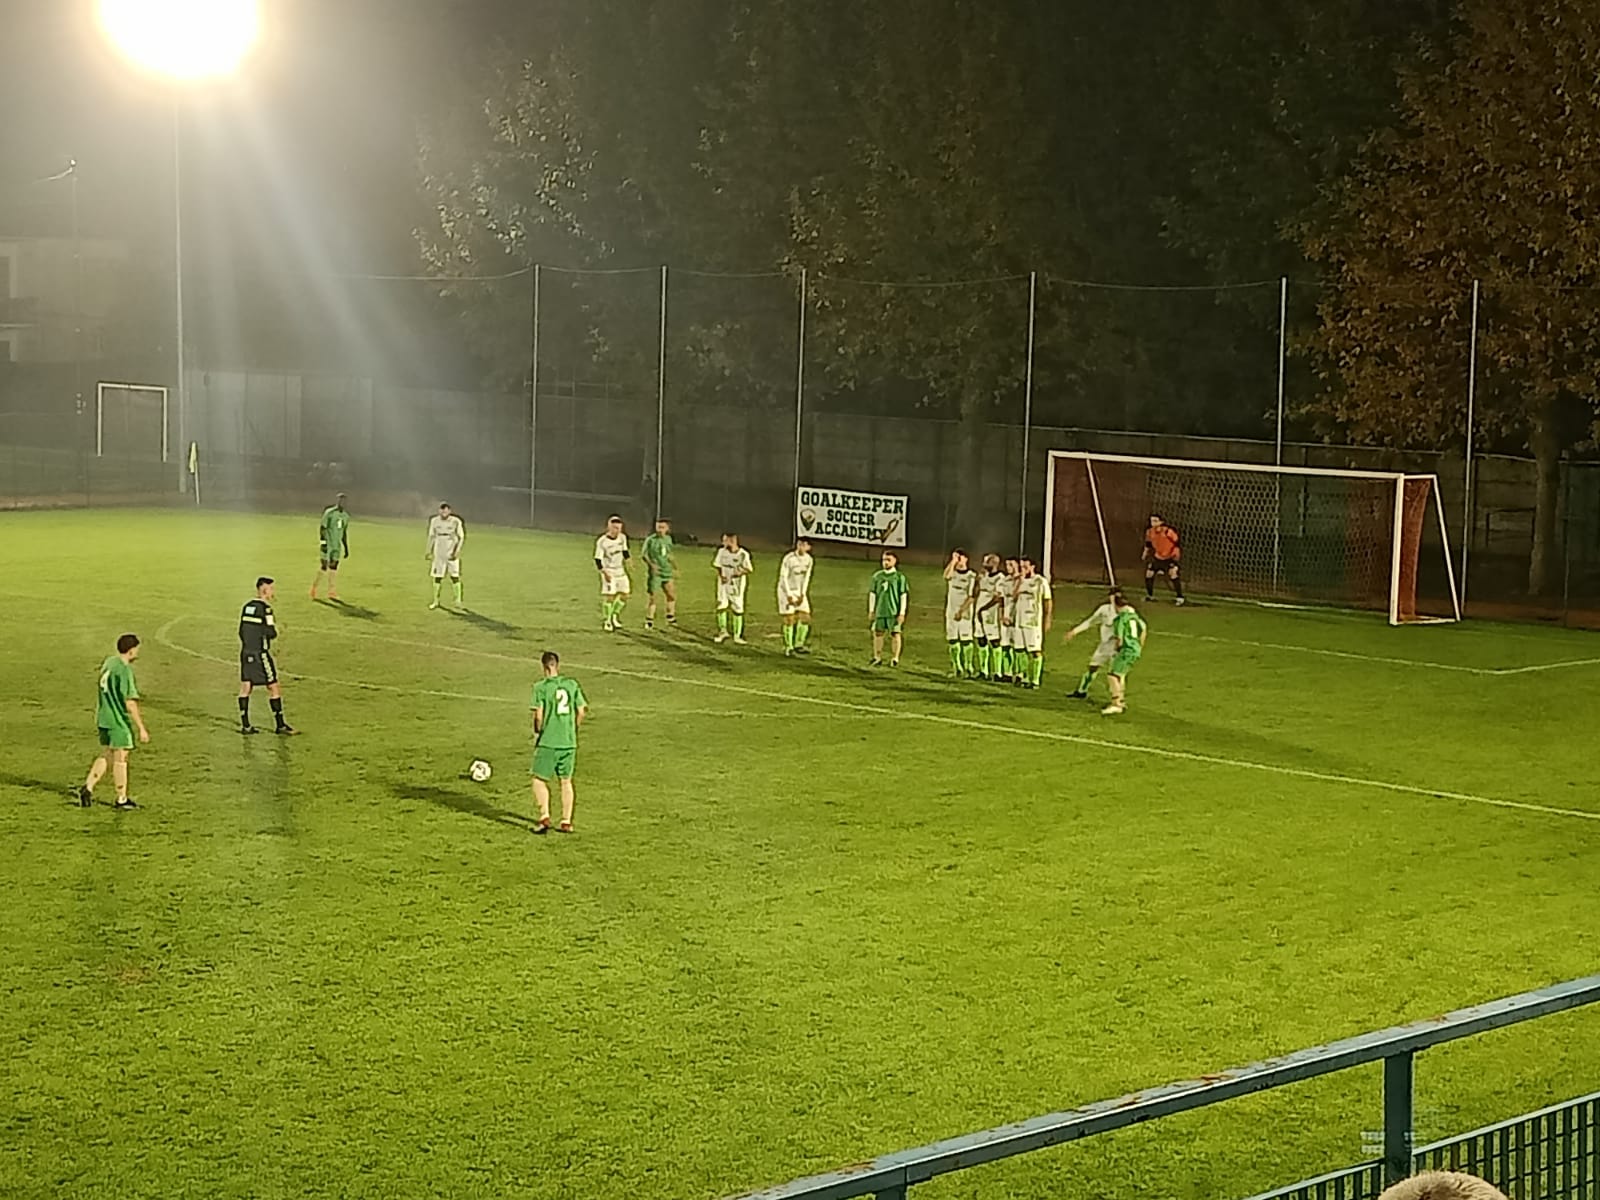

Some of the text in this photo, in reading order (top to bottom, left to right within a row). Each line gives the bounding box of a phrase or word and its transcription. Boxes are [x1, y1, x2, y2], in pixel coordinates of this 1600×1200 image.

[801, 491, 903, 513] GOALKEEPER
[827, 509, 875, 526] SOCCER
[556, 688, 570, 715] 2
